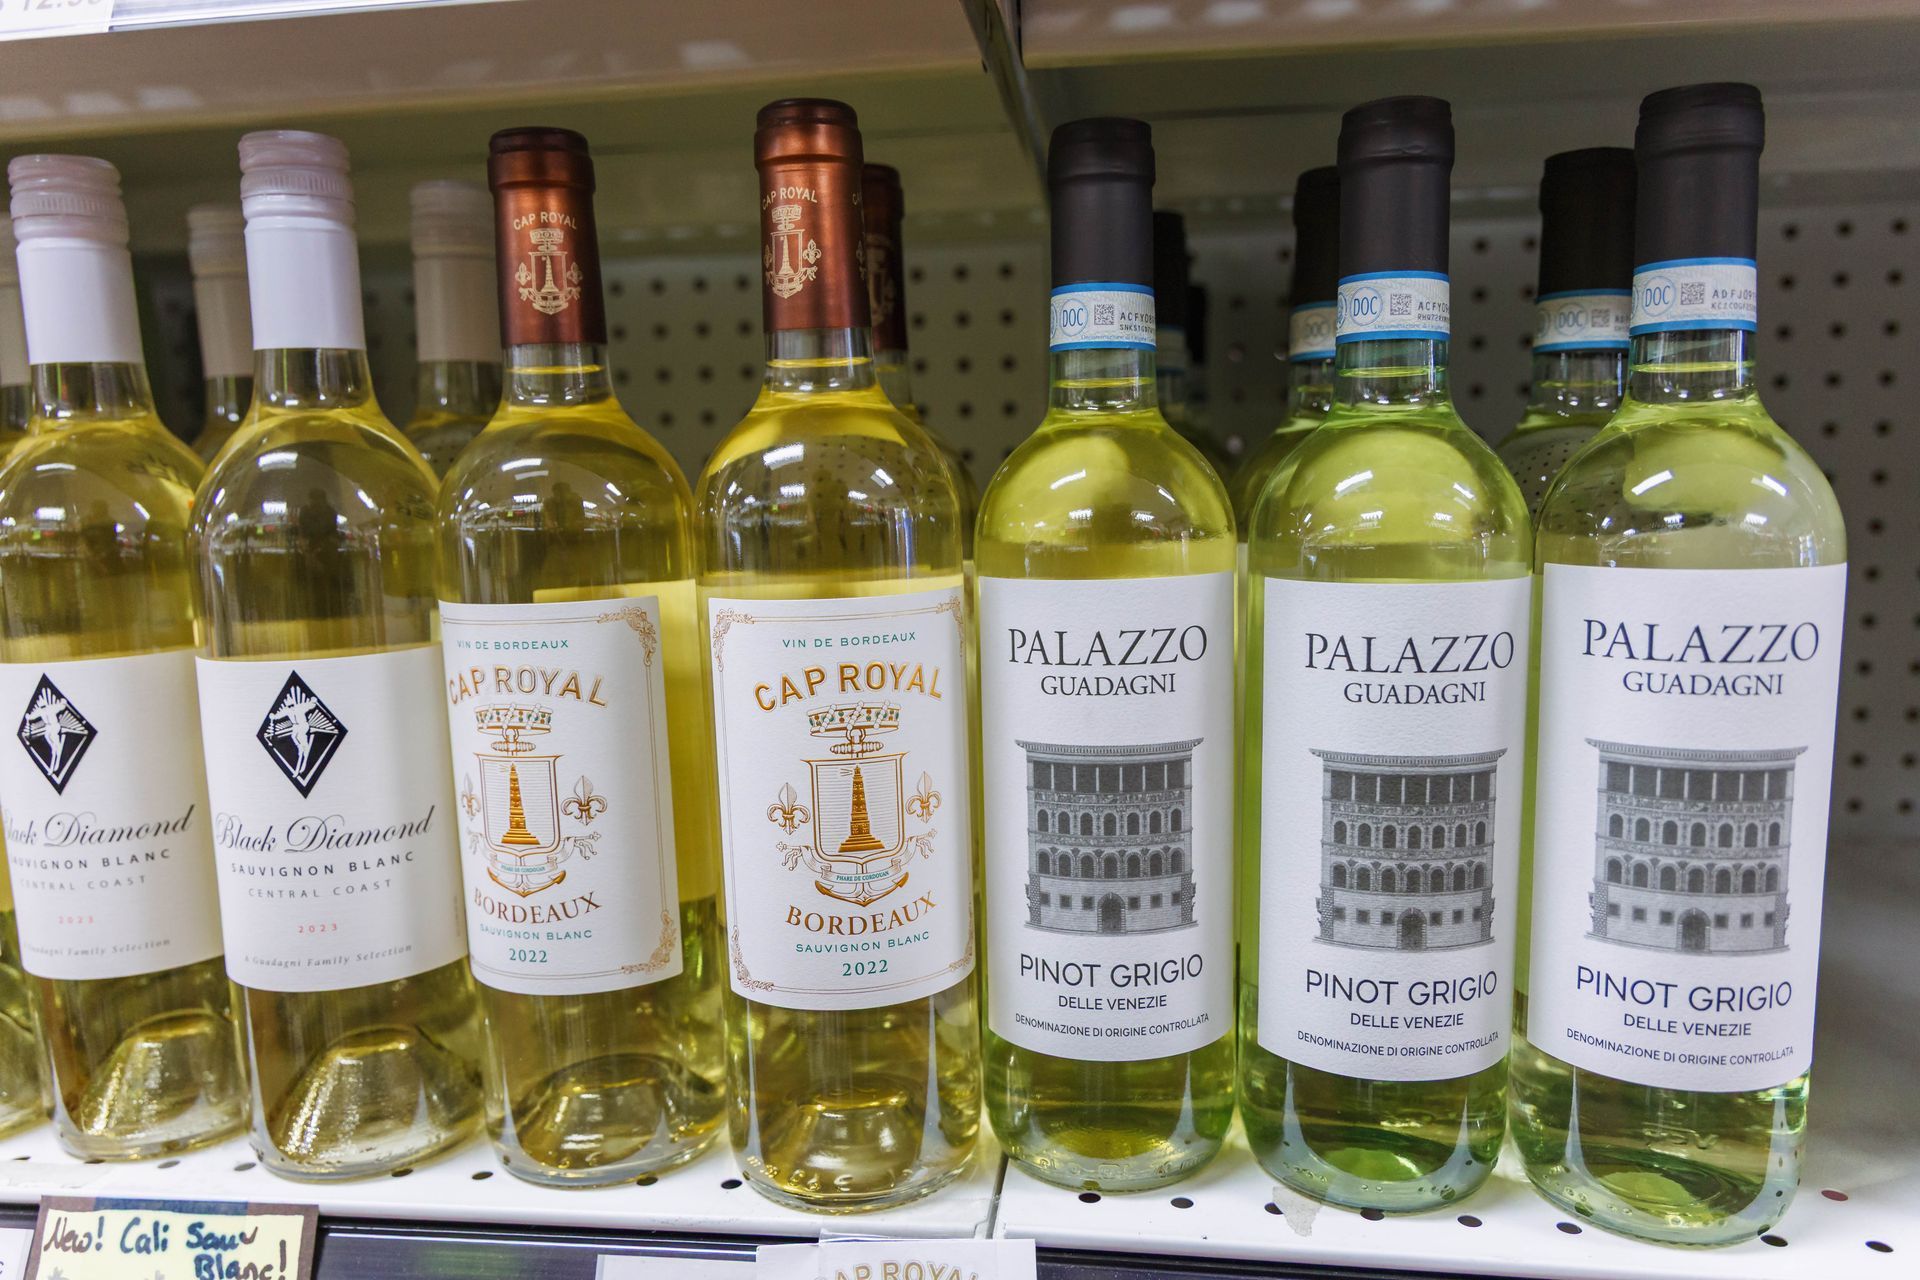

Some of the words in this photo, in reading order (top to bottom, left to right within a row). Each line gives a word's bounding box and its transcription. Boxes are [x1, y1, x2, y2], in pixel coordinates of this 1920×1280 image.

[762, 190, 777, 211] CAP
[779, 186, 818, 204] ROYAL
[513, 212, 536, 230] CAP
[540, 211, 577, 230] ROYAL
[1353, 295, 1378, 317] DOC
[1645, 285, 1671, 308] DOC
[1062, 307, 1084, 328] DOC
[456, 639, 471, 649] VIN
[475, 640, 489, 650] DE
[494, 639, 569, 650] BORDEAUX
[782, 638, 806, 648] VIN
[814, 638, 833, 648] DE
[840, 631, 916, 647] BORDEAUX
[1008, 625, 1207, 667] PALAZZO
[1582, 618, 1819, 664] PALAZZO
[1304, 631, 1515, 674] PALAZZO
[448, 665, 486, 705] CAP
[494, 664, 608, 708] ROYAL
[753, 665, 827, 713] CAP
[838, 660, 945, 701] ROYAL
[1040, 672, 1177, 697] GUADAGNI
[1343, 681, 1486, 705] GUADAGNI
[1622, 670, 1784, 697] GUADAGNI
[43, 804, 196, 848] Diamond
[215, 811, 277, 852] Black
[284, 805, 436, 853] Diamond
[101, 848, 171, 868] BLANC
[231, 862, 335, 877] SAUVIGNON
[349, 851, 415, 873] BLANC
[87, 875, 147, 890] COAST
[248, 887, 320, 899] CENTRAL
[332, 879, 392, 896] COAST
[473, 887, 603, 925] BORDEAUX
[785, 890, 937, 936] BORDEAUX
[298, 923, 339, 934] 2023
[479, 923, 541, 941] SAUVIGNON
[546, 929, 593, 941] BLANC
[796, 940, 881, 953] SAUVIGNON
[887, 930, 930, 948] BLANC
[306, 954, 351, 968] Family
[356, 944, 412, 962] Selection
[508, 947, 548, 963] 2022
[842, 959, 888, 977] 2022
[1020, 952, 1101, 988] PINOT
[1110, 953, 1203, 988] GRIGIO
[1306, 968, 1399, 1006] PINOT
[1408, 970, 1497, 1006] GRIGIO
[1577, 965, 1678, 1009] PINOT
[1688, 981, 1792, 1012] GRIGIO
[1058, 995, 1103, 1010] DELLE
[1106, 994, 1167, 1010] VENEZIE
[1015, 1012, 1090, 1037] DENOMINAZIONE
[1092, 1028, 1103, 1037] DI
[1105, 1027, 1147, 1037] ORIGINE
[1149, 1012, 1210, 1036] CONTROLLATA
[1350, 1012, 1399, 1029] DELLE
[1403, 1012, 1464, 1029] VENEZIE
[1623, 1013, 1678, 1034] DELLE
[1682, 1022, 1752, 1037] VENEZIE
[1297, 1030, 1385, 1056] DENOMINAZIONE
[1387, 1047, 1398, 1057] DI
[1400, 1045, 1443, 1057] ORIGINE
[1445, 1031, 1499, 1055] CONTROLLATA
[1566, 1027, 1660, 1061] DENOMINAZIONE
[1663, 1050, 1676, 1063] DI
[1678, 1050, 1727, 1066] ORIGINE
[1729, 1046, 1794, 1065] CONTROLLATA
[43, 1215, 106, 1252] New!
[119, 1216, 170, 1255] Cali
[193, 1239, 287, 1280] Blanc!
